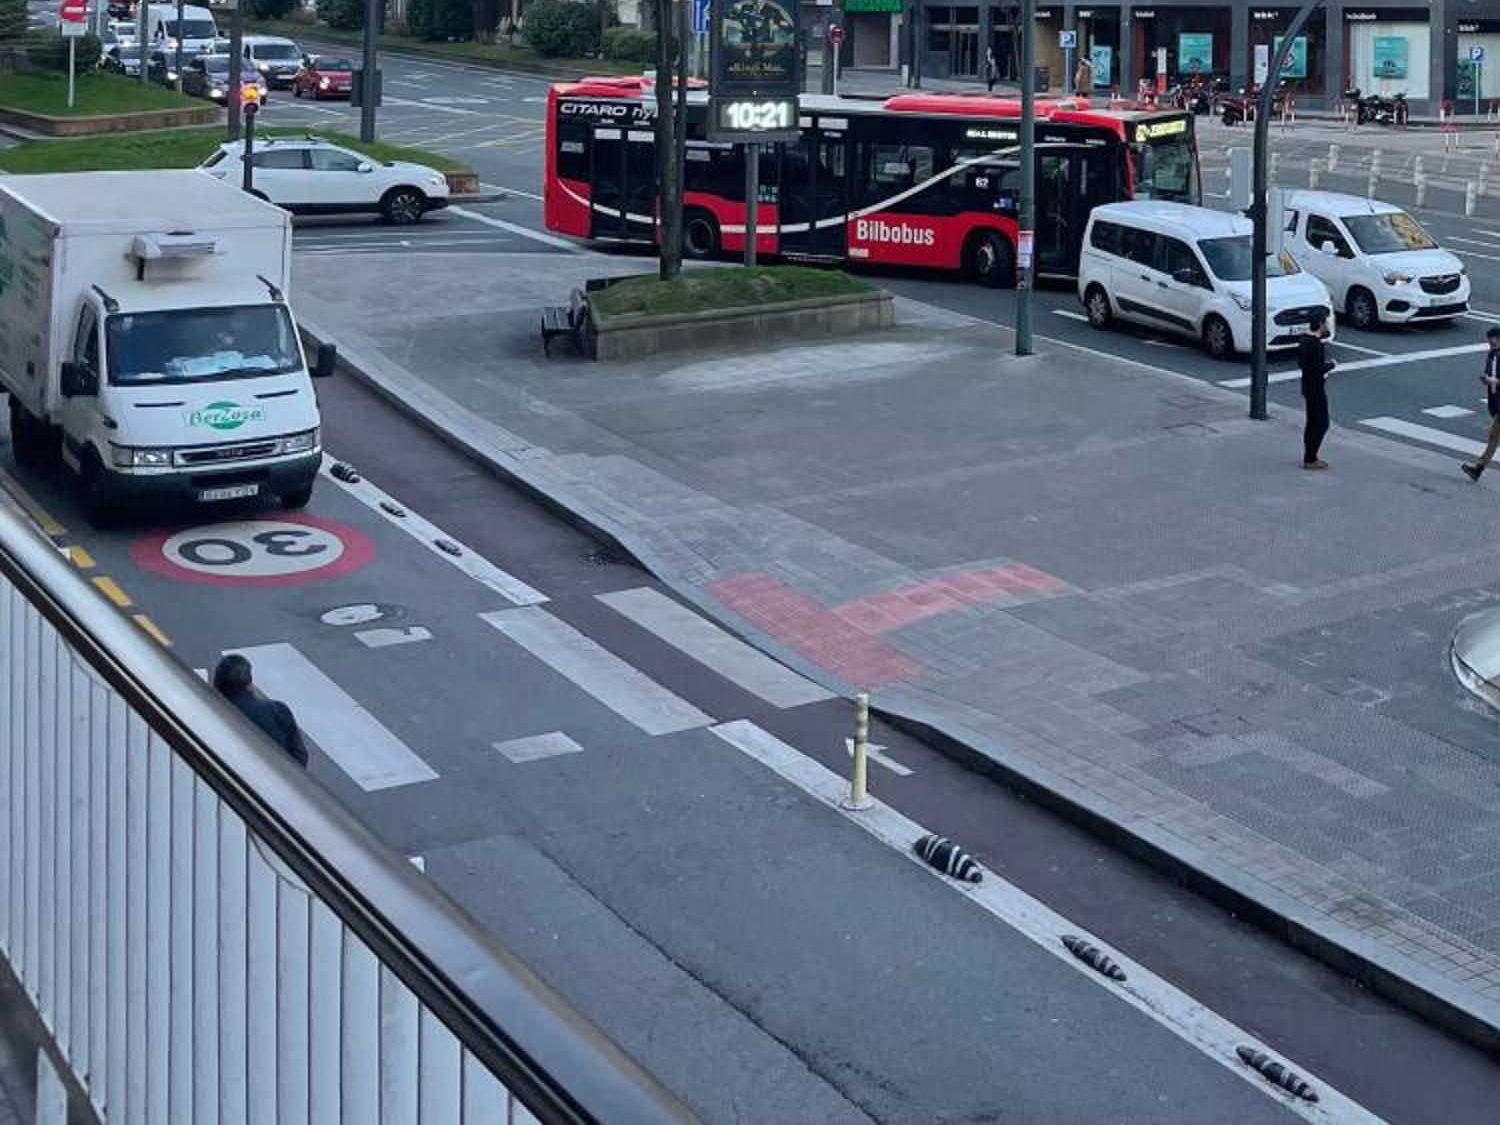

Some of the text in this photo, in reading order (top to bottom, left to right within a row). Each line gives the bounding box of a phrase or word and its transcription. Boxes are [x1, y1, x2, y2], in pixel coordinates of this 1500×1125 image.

[560, 103, 627, 116] CITARO
[726, 102, 788, 128] 10:21
[857, 220, 935, 246] Bilbobus
[178, 530, 326, 566] 30
